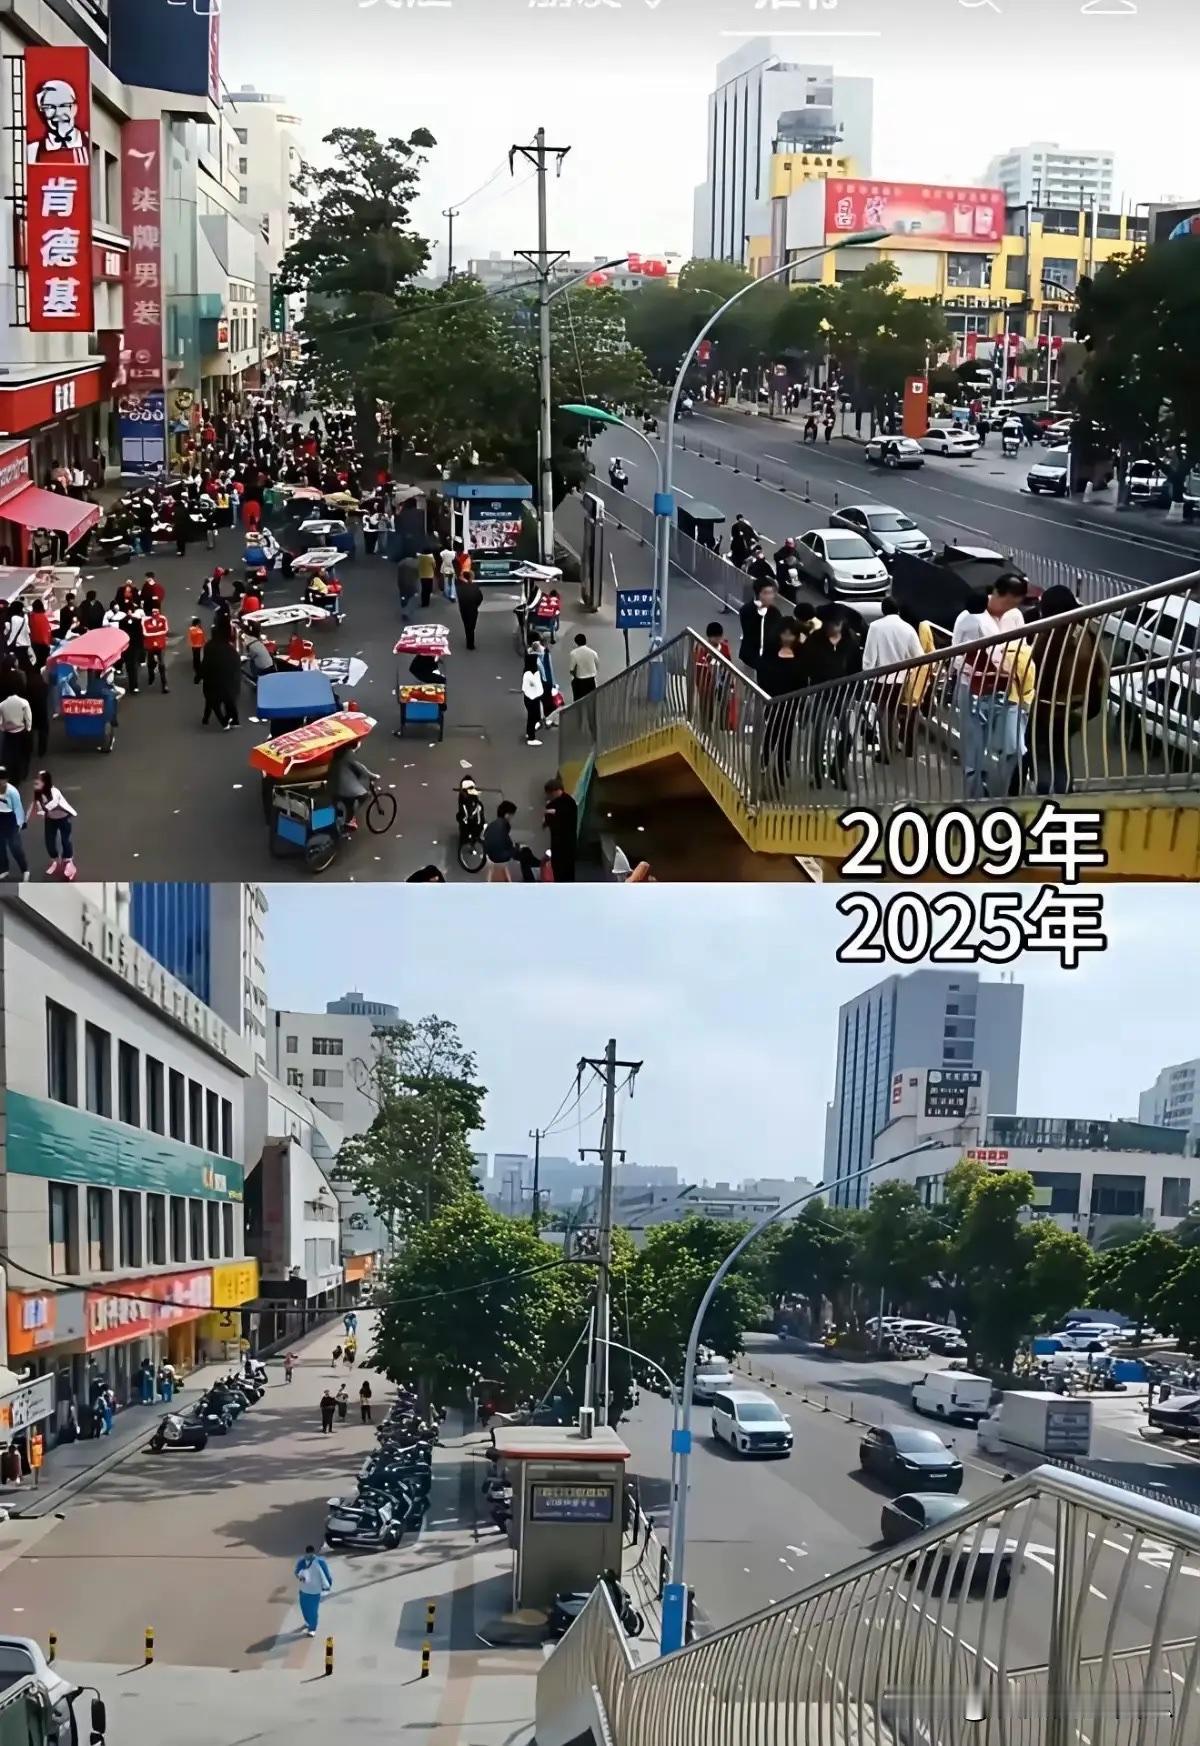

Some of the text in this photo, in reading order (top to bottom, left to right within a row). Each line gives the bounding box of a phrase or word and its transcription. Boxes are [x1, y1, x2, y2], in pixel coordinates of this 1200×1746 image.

[41, 177, 81, 318] 肯德基
[131, 187, 161, 325] 柒牌男装
